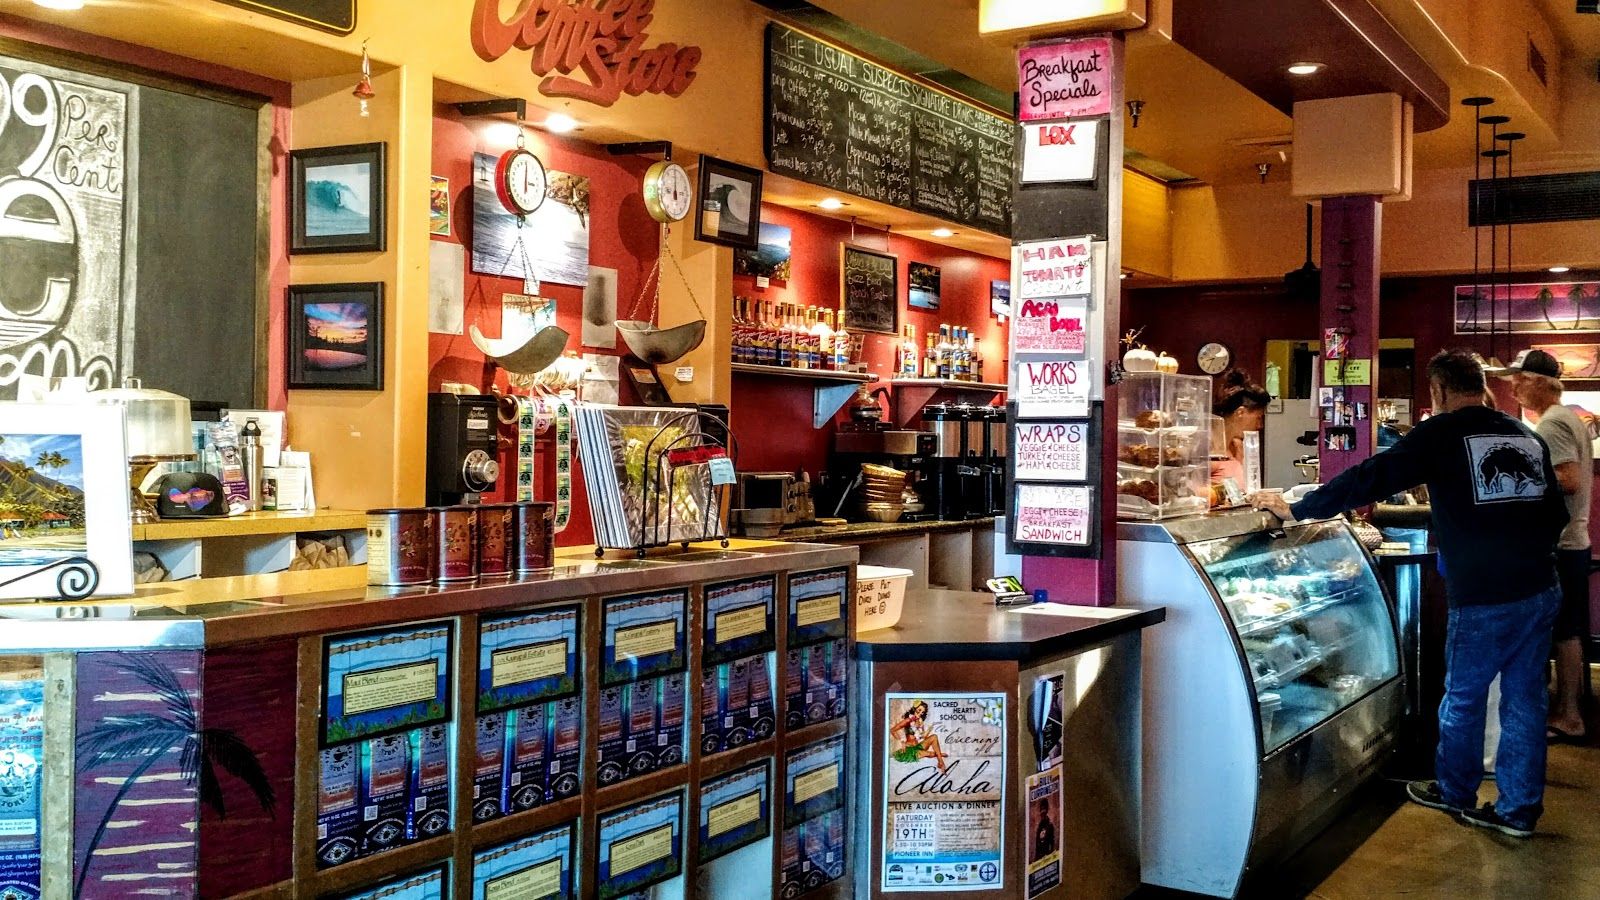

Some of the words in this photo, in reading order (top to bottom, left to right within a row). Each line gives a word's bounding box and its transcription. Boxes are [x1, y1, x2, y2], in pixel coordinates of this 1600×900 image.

[538, 33, 702, 107] Store
[781, 29, 805, 58] THE
[814, 43, 857, 78] USUAL
[862, 62, 911, 98] SUSPECTS
[1022, 50, 1102, 87] Breakfast
[911, 84, 951, 116] SIGNATURE
[1030, 79, 1102, 111] Specials
[1039, 126, 1076, 147] LOX
[53, 145, 122, 193] Cent
[1022, 244, 1088, 263] HAM
[1022, 265, 1086, 283] TOMATO
[1049, 316, 1083, 333] BOWL
[1027, 361, 1078, 385] WORKS
[1030, 384, 1075, 395] BAGEL
[1016, 425, 1081, 443] WRAPS
[1018, 452, 1047, 461] TURKEY
[1053, 453, 1081, 461] CHEESE
[1053, 444, 1081, 452] CHEESE
[1026, 461, 1046, 470] HAM
[1052, 461, 1081, 470] CHEESE
[1049, 507, 1079, 517] CHEESE
[1022, 525, 1082, 542] SANDWICH
[1028, 520, 1073, 529] BREAKFAST
[894, 759, 995, 796] Aloha
[894, 803, 913, 811] LIVE
[916, 802, 954, 811] AUCTION
[957, 802, 963, 810] &
[966, 801, 996, 809] DINNER
[896, 828, 927, 839] 19TH
